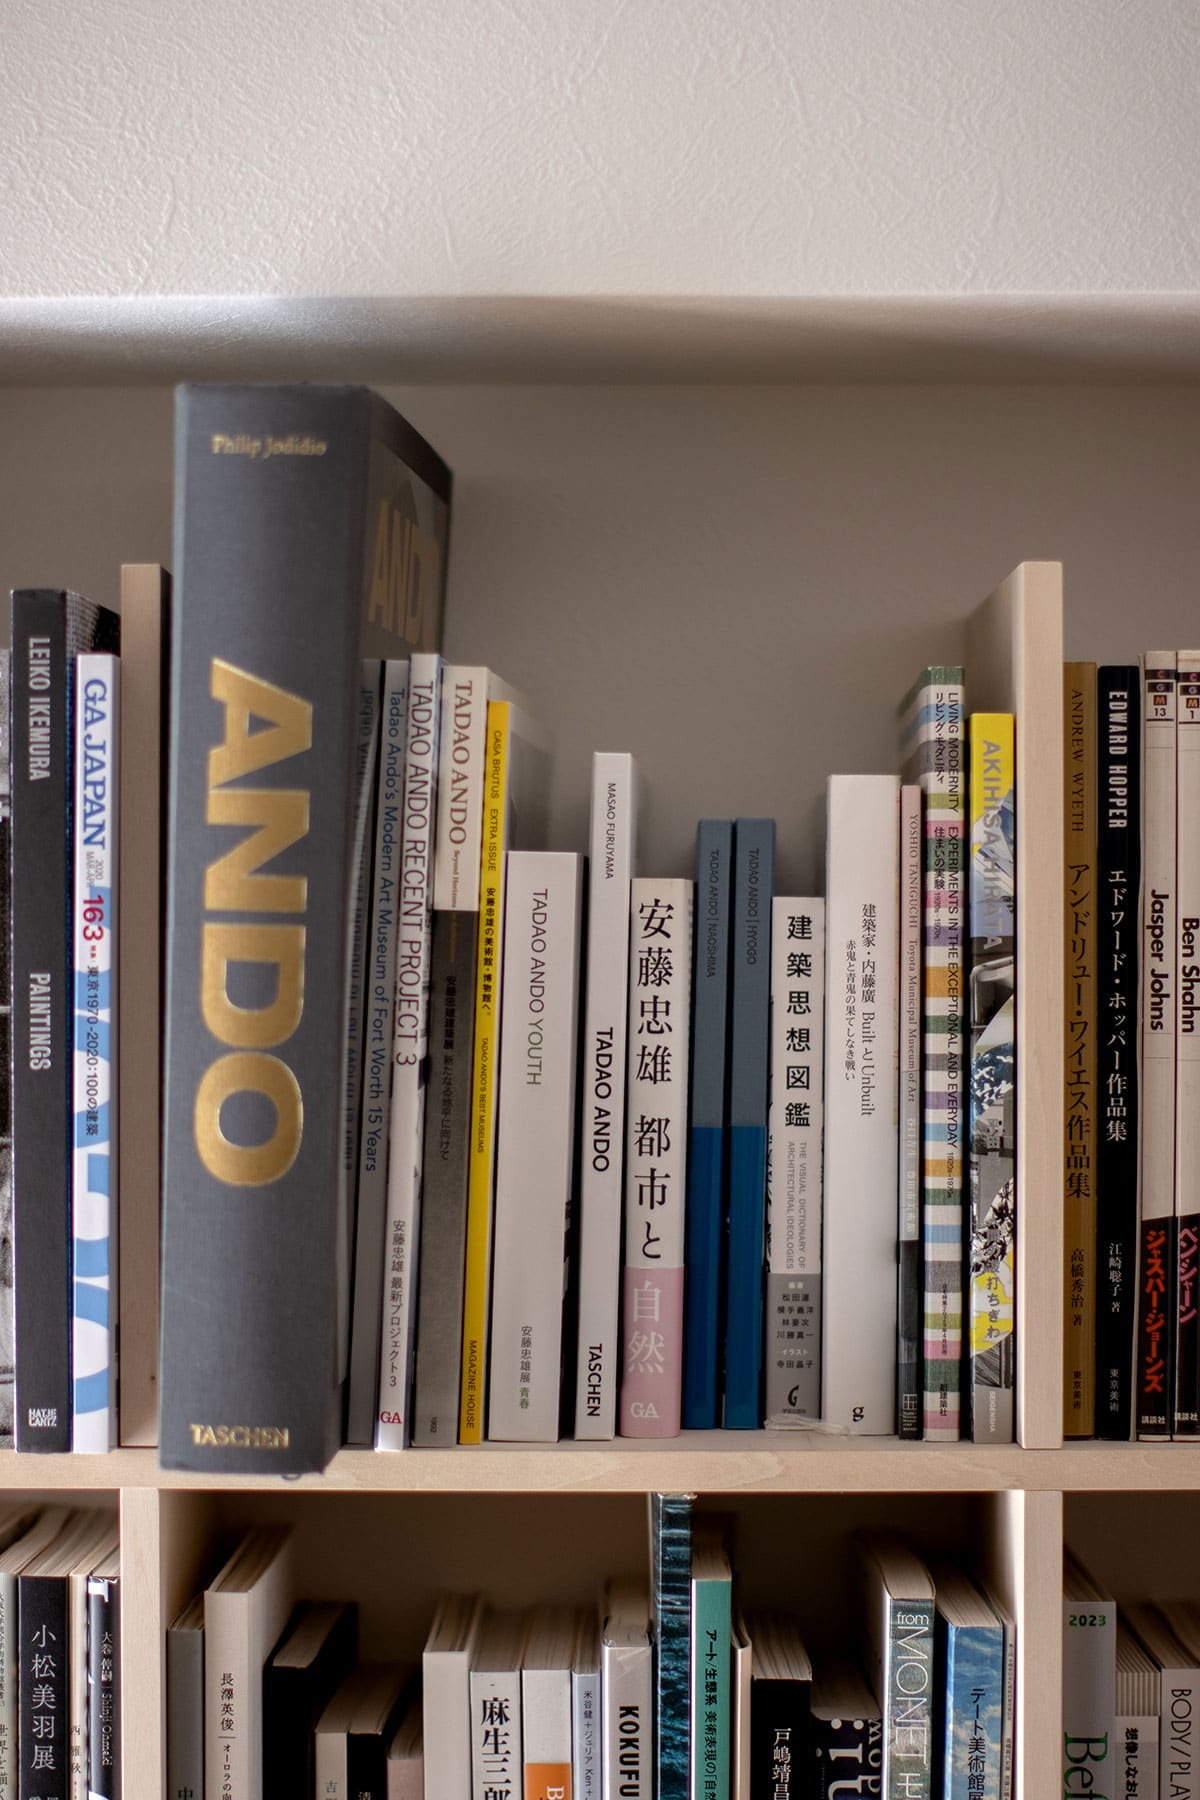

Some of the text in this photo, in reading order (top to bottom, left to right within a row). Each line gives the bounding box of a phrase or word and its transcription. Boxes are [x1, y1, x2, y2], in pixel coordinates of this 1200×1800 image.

[211, 434, 327, 459] Philip Jodidio
[30, 637, 50, 781] LEIKO IKEMURA
[948, 692, 959, 734] LIVING
[1154, 707, 1167, 717] 13
[1155, 695, 1166, 704] M
[1157, 671, 1165, 679] C
[1187, 698, 1198, 708] M
[1188, 686, 1197, 694] G
[1189, 673, 1197, 681] C
[1190, 710, 1195, 719] 1
[451, 680, 473, 765] TADAO
[935, 692, 946, 784] リビング・モダニティ
[1071, 688, 1084, 832] ANDREW WYETH
[1109, 690, 1128, 829] EDWARD HOPPER
[82, 678, 107, 849] GA JAPAN
[487, 729, 503, 871] CASA BRUTUS EXTRA ISSUE
[948, 738, 959, 813] MODERNITY
[449, 769, 469, 846] ANDO
[605, 782, 617, 879] MASAO FURUYAMA
[982, 739, 1003, 950] AKIHISA HIRATA
[95, 860, 104, 880] 2020
[396, 681, 434, 1067] TADAO ANDO RECENT PROJECT 3
[450, 850, 461, 876] Beyond
[451, 877, 460, 908] Horizons
[909, 814, 919, 928] YOSHIO TANIGUCHI
[948, 826, 959, 914] EXPERIMENTS
[83, 893, 104, 940] 163
[194, 657, 314, 1187] ANDO
[365, 688, 405, 1172] Tadao Ando's Modern Art Museum of Fort Worth 15 Years
[706, 849, 719, 978] TADAO ANDO NAOSHIMA
[746, 848, 759, 965] TADAO ANDO HYOGO
[948, 918, 958, 930] IN
[948, 934, 958, 958] THE
[526, 888, 548, 1085] TADAO ANDO YOUTH
[861, 903, 877, 1004] 建築家・内藤廣
[1146, 889, 1171, 1031] Jasper Johns
[1182, 917, 1200, 1032] Ben Shahn
[30, 972, 50, 1071] PAINTINGS
[784, 915, 812, 1127] 建築思想図鑑
[844, 940, 857, 1081] 赤鬼と青鬼の果てしなき戦い
[906, 939, 918, 1102] Toyota Municipal Museum of Art
[947, 963, 958, 1048] EXCEPTIONAL
[1064, 863, 1091, 1199] アンドリュー・ワイエス作品集
[1106, 869, 1128, 1142] エドワード・ホッパー作品集
[480, 1037, 490, 1060] TADAO
[947, 1051, 958, 1080] AND
[476, 1115, 486, 1152] MUSEUMS
[478, 1094, 487, 1112] BEST
[592, 1027, 614, 1172] TADAO ANDO
[628, 898, 673, 1374] 安藤忠雄 都市と自然
[947, 1083, 958, 1149] EVERYDAY
[786, 1142, 796, 1269] ARCHITECTURAL IDEOLOGIES
[798, 1141, 808, 1269] THE VISUAL DICTIONARY OF
[389, 1219, 406, 1388] 安藤忠雄 最新プロジェクト3
[1070, 1248, 1084, 1327] 高橋秀治 著
[1108, 1242, 1122, 1312] 江崎聡子 著
[1144, 1229, 1166, 1393] ジャスパー・ジョーンズ
[1180, 1227, 1198, 1323] ベン・シャーン
[466, 1338, 479, 1427] MAGAZINE HOUSE
[519, 1326, 533, 1383] 安藤忠雄展
[587, 1343, 603, 1417] TASCHEN
[1109, 1369, 1119, 1412] 東京美術
[190, 1424, 288, 1448] TASCHEN
[380, 1411, 402, 1425] GA
[630, 1402, 659, 1419] GA
[852, 1406, 865, 1423] g
[1141, 1415, 1166, 1425] 講談社
[1174, 1412, 1199, 1422] 講談社
[896, 1611, 929, 1625] from
[1069, 1615, 1106, 1627] 2023
[30, 1624, 57, 1772] 小松美羽展
[220, 1672, 234, 1732] 長澤英俊
[704, 1629, 718, 1706] アート/生態系
[895, 1625, 930, 1765] MONET
[99, 1692, 113, 1766] Shinji Ohmaki
[619, 1705, 640, 1797] KOKUFU
[584, 1769, 594, 1787] Ken
